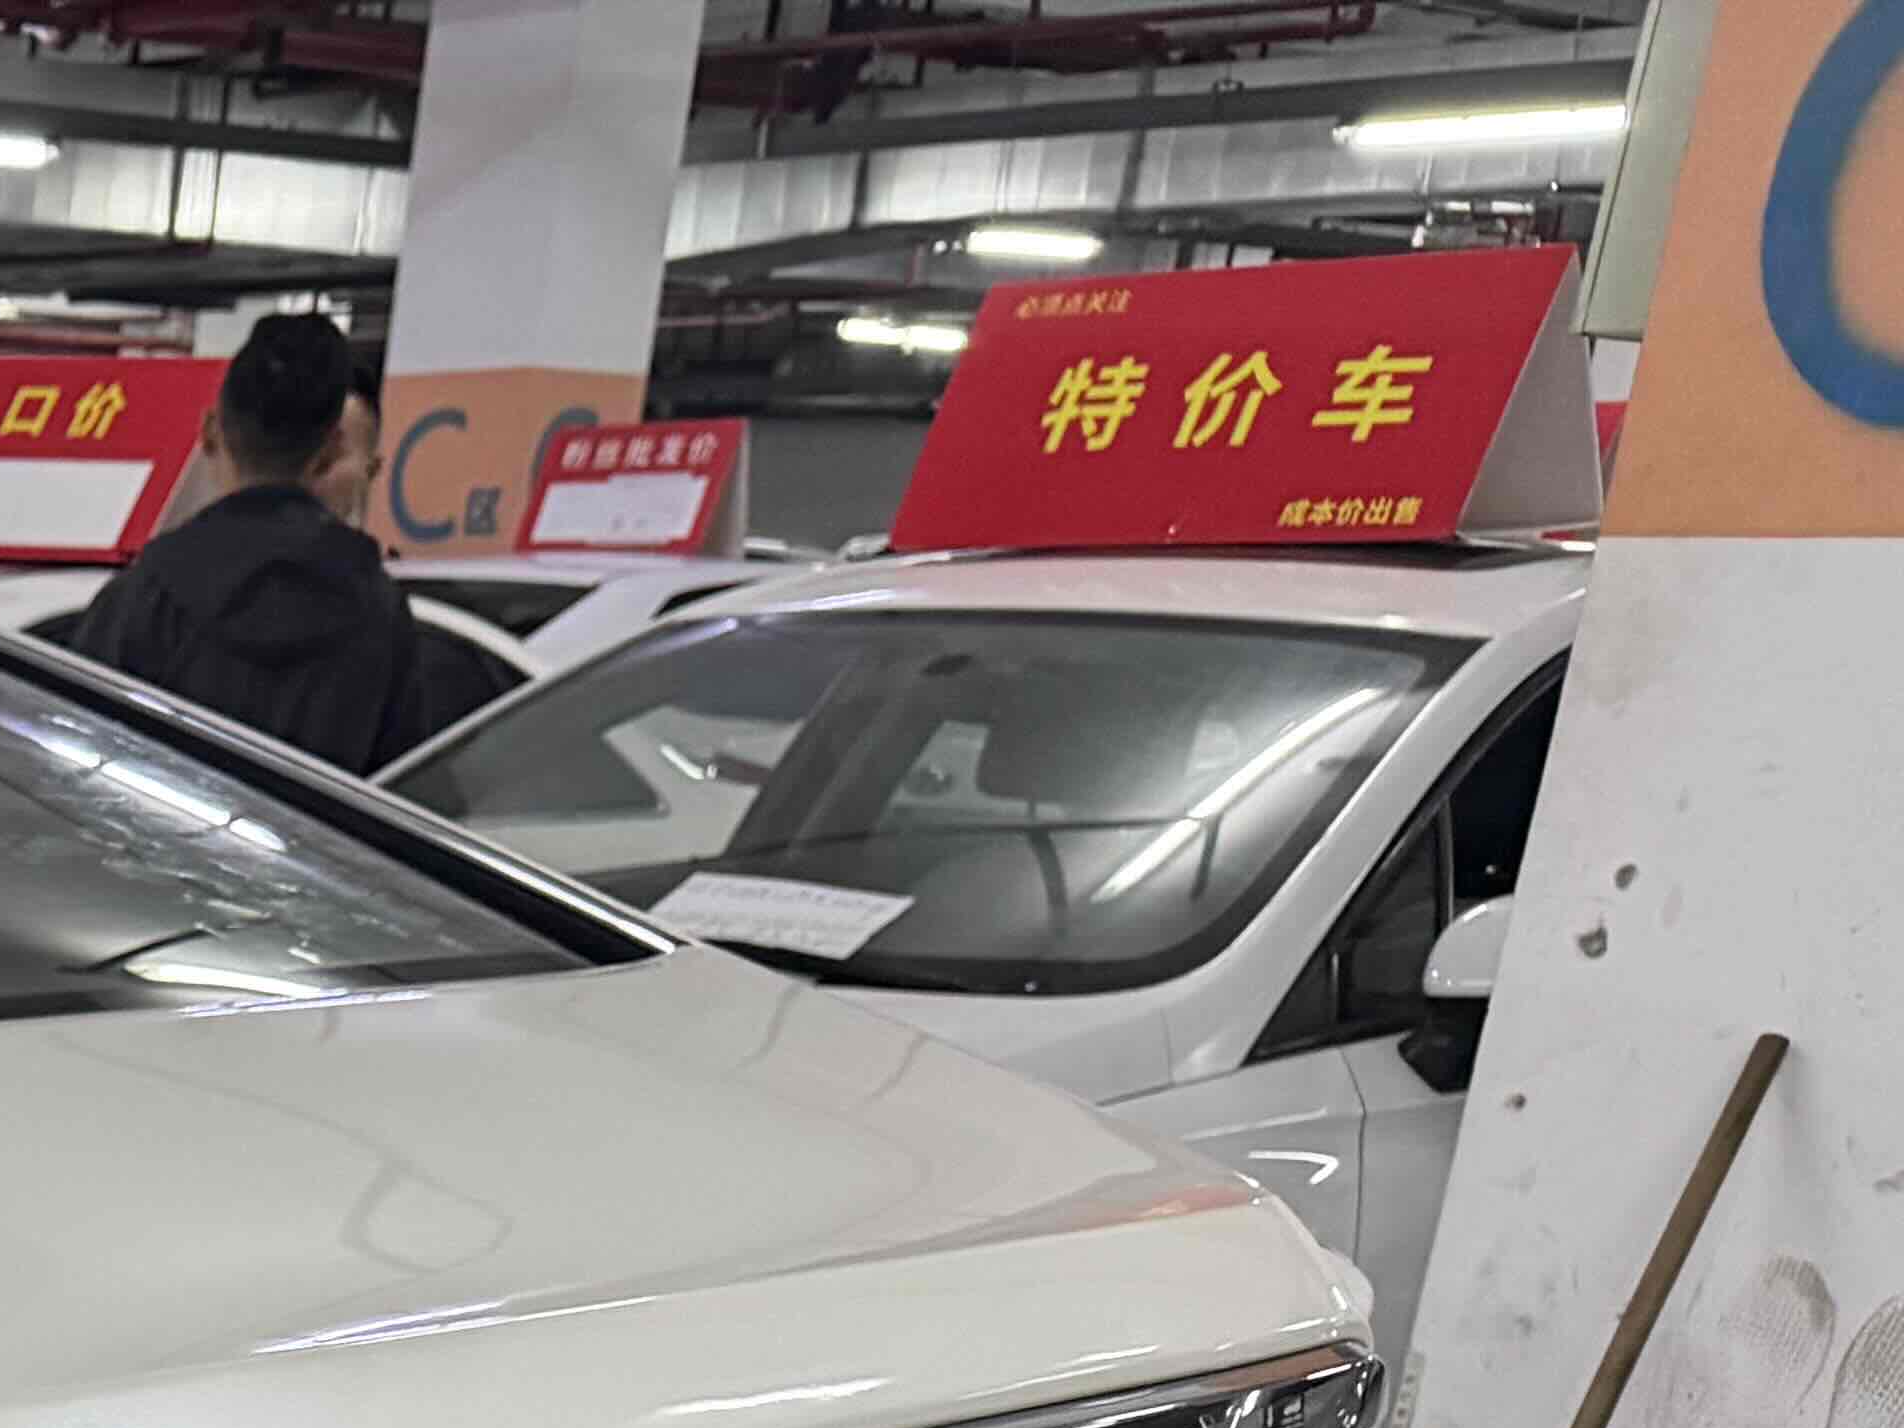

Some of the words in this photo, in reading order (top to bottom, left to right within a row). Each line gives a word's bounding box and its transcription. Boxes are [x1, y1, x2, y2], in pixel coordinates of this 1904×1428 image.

[1041, 344, 1434, 455] 特价车
[1278, 496, 1423, 528] 成本价出售
